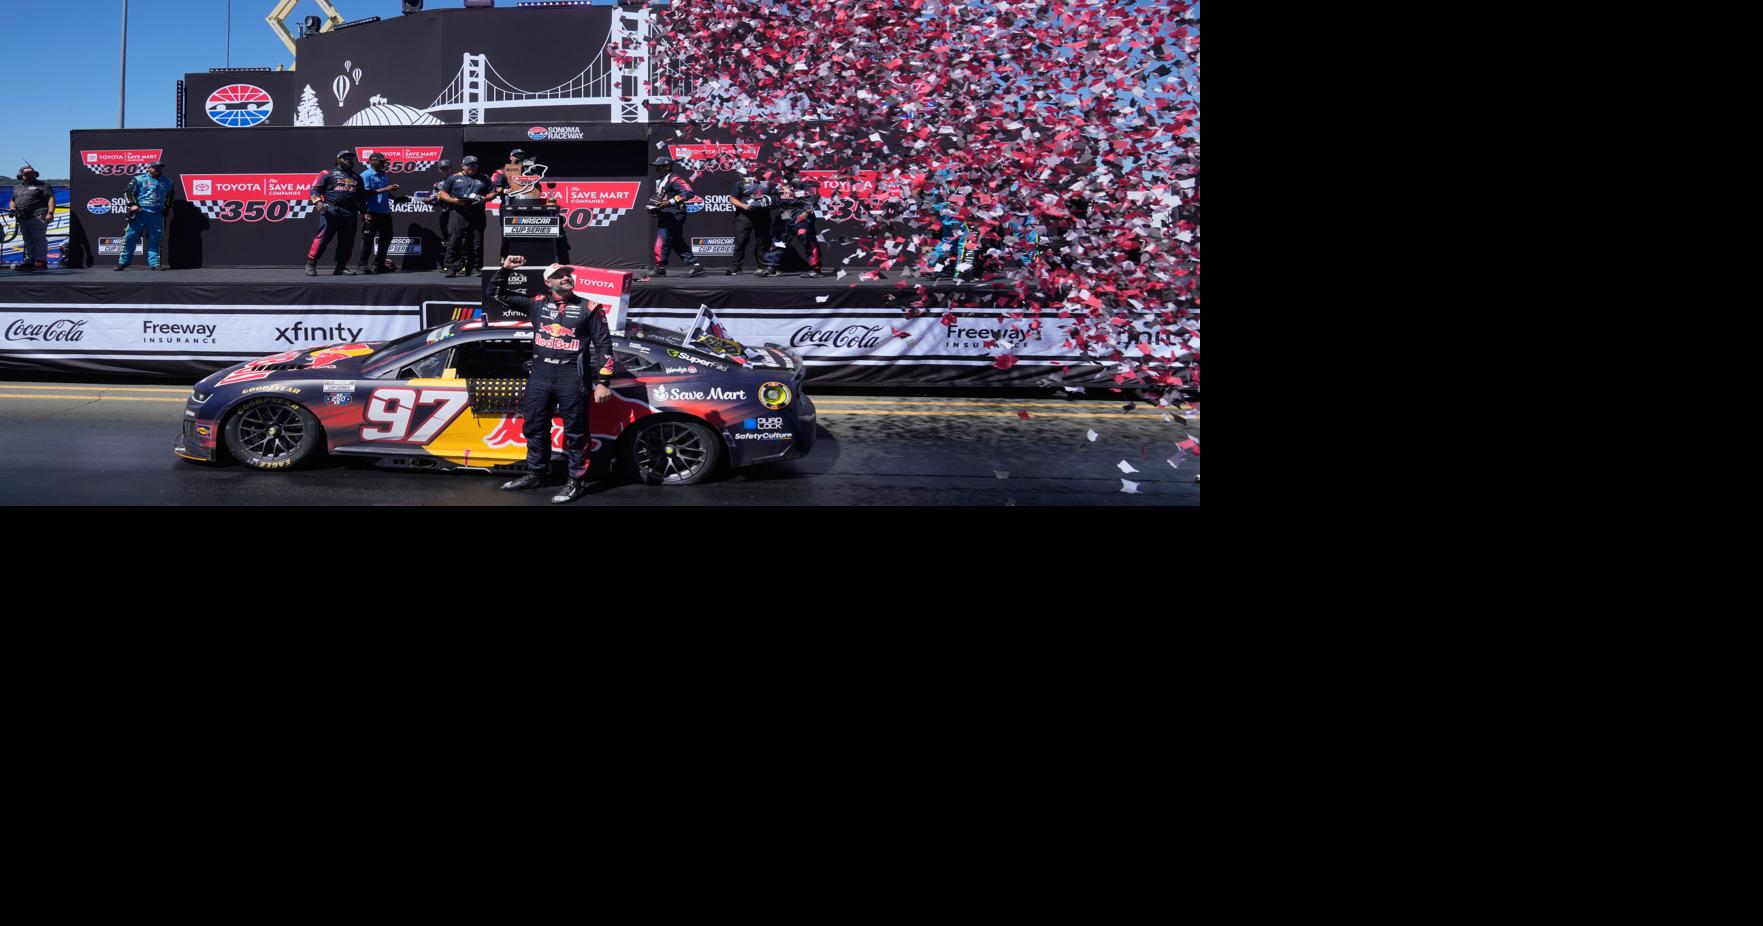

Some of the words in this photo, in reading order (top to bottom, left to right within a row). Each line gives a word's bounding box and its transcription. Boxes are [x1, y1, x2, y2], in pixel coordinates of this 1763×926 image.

[101, 164, 138, 176] 350
[215, 183, 261, 191] TOYOTA
[268, 183, 293, 191] SAVE
[296, 183, 312, 191] MA
[571, 191, 595, 199] SAVE
[597, 191, 629, 199] MART
[220, 200, 290, 222] 350
[579, 278, 615, 289] TOYOTA
[4, 318, 89, 342] Coca-Cola
[143, 320, 217, 338] Freeway
[274, 321, 364, 345] xfinity
[789, 324, 884, 349] Coca-Cola
[535, 333, 554, 348] Red
[553, 337, 580, 351] Bull
[241, 383, 302, 395] GOODYEAR
[670, 388, 705, 401] Save
[706, 387, 747, 401] Mart
[360, 386, 471, 445] 97
[734, 432, 793, 441] SafetyCulture
